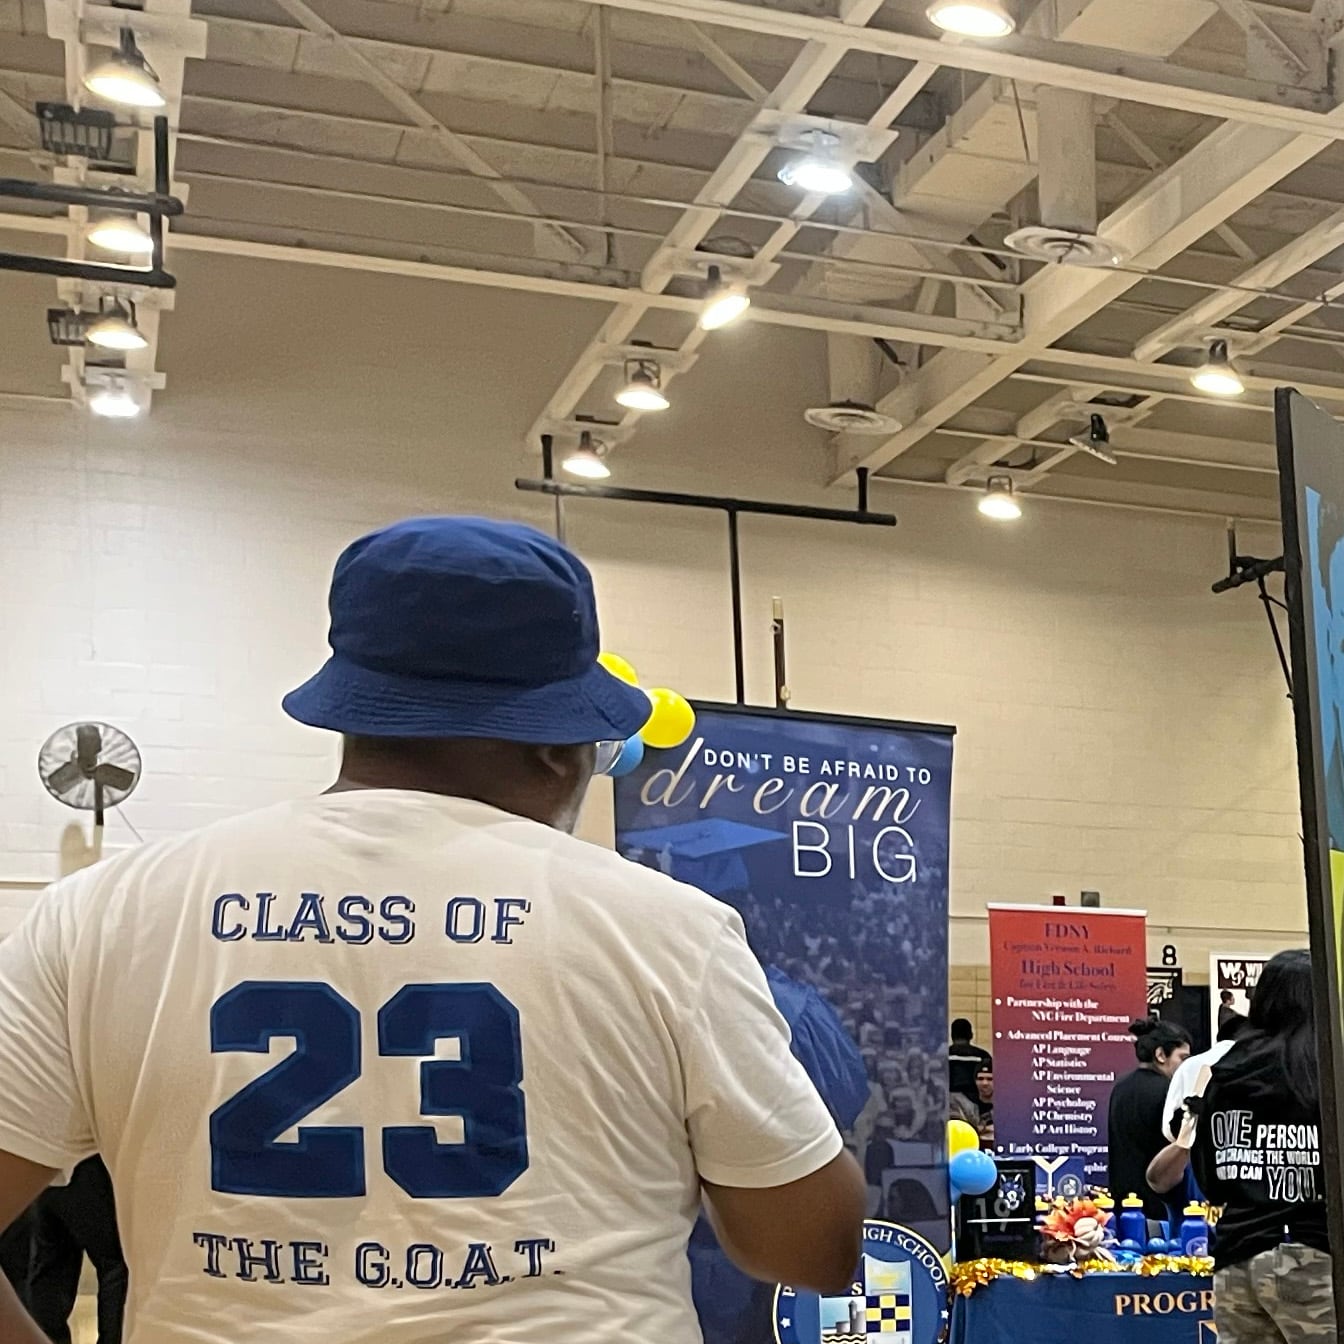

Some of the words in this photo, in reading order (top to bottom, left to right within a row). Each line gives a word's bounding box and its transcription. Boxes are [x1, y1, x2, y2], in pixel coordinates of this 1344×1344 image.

[703, 749, 773, 770] DON'T
[783, 756, 810, 774] BE
[820, 760, 898, 781] AFRAID
[906, 767, 931, 785] TO
[640, 737, 921, 824] dream
[792, 820, 917, 883] BIG
[211, 892, 415, 944] CLASS
[445, 896, 531, 944] OF
[1045, 923, 1090, 939] FDNY
[1162, 944, 1177, 966] 8
[1022, 959, 1060, 977] High
[1063, 961, 1115, 977] School
[1006, 997, 1062, 1010] Partnership
[1063, 998, 1083, 1009] with
[1083, 999, 1099, 1009] the
[1032, 1011, 1054, 1021] NYC
[1055, 1012, 1074, 1022] Fire
[1075, 1013, 1130, 1024] Department
[1007, 1030, 1053, 1040] Advanced
[1053, 1031, 1100, 1041] Placement
[1101, 1032, 1138, 1042] Courses
[1032, 1044, 1046, 1054] AP
[1047, 1044, 1092, 1056] Language
[1032, 1057, 1046, 1067] AP
[1046, 1057, 1087, 1067] Statistics
[1032, 1070, 1046, 1081] AP
[1047, 1071, 1115, 1081] Environmental
[209, 979, 529, 1198] 23
[1047, 1084, 1081, 1094] Science
[1032, 1098, 1046, 1107] AP
[1047, 1098, 1097, 1110] Psychology
[1032, 1111, 1046, 1121] AP
[1047, 1111, 1093, 1122] Chemistry
[1032, 1124, 1046, 1134] AP
[1050, 1125, 1064, 1134] Art
[1064, 1124, 1098, 1136] History
[1211, 1110, 1254, 1149] ONE
[1256, 1124, 1319, 1149] PERSON
[1009, 1143, 1034, 1155] Early
[1035, 1143, 1070, 1155] College
[1265, 1150, 1285, 1165] THE
[1286, 1151, 1320, 1166] WORLD
[1240, 1165, 1263, 1180] CAN
[193, 1231, 330, 1286] THE
[355, 1238, 567, 1290] G.O.A.T.
[864, 1227, 892, 1243] IGH
[896, 1233, 948, 1292] SCHOOL
[1115, 1290, 1215, 1316] PROGR
